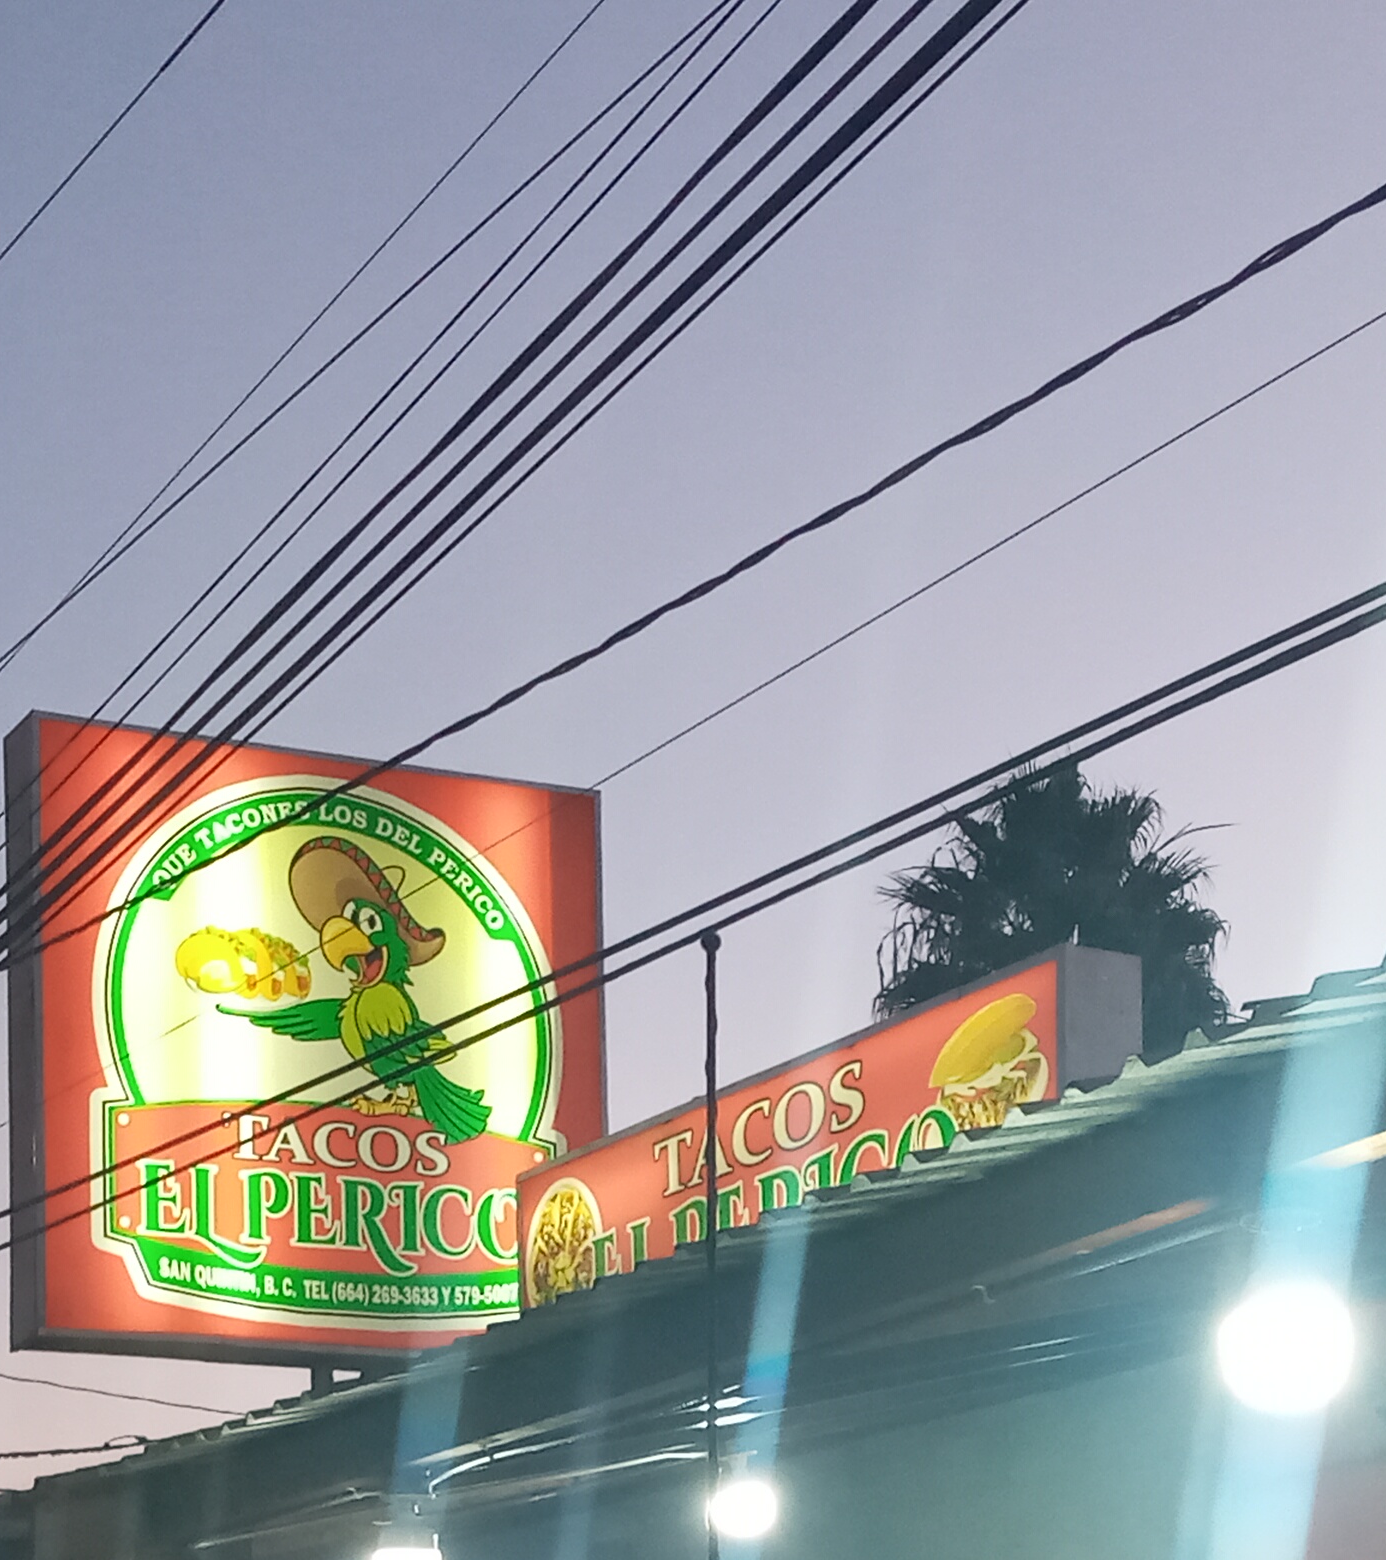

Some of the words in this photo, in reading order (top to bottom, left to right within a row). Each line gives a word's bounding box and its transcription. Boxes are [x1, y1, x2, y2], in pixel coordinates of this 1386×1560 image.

[319, 802, 368, 829] LOS
[375, 816, 424, 855] DEL
[427, 846, 505, 931] PERICO
[222, 1111, 451, 1176] TACOS
[653, 1060, 867, 1198] TACOS
[138, 1158, 267, 1269] EL
[239, 1167, 517, 1278] PERICO
[158, 1257, 192, 1283] SAN
[303, 1279, 330, 1300] TEL
[332, 1281, 370, 1307] (664)
[372, 1284, 438, 1306] 269-3633
[441, 1286, 452, 1306] Y
